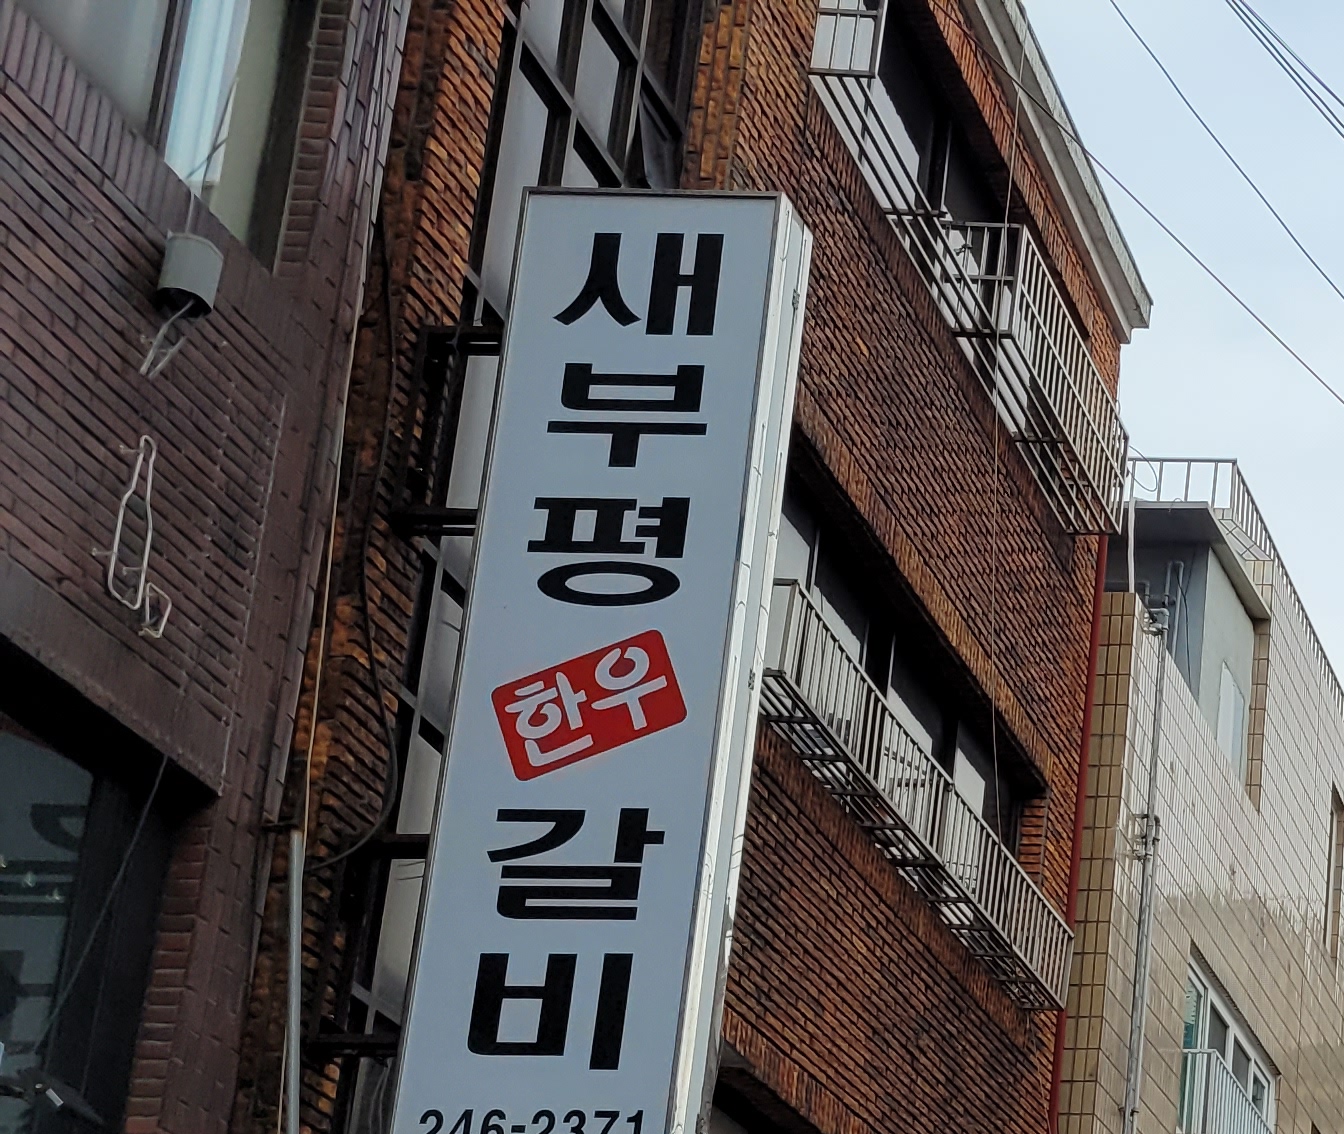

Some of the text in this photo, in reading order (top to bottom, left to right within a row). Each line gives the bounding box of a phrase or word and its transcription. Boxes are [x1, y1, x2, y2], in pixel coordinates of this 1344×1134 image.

[527, 233, 724, 608] 새부평
[505, 644, 672, 767] 한우
[467, 807, 667, 1070] 갈비
